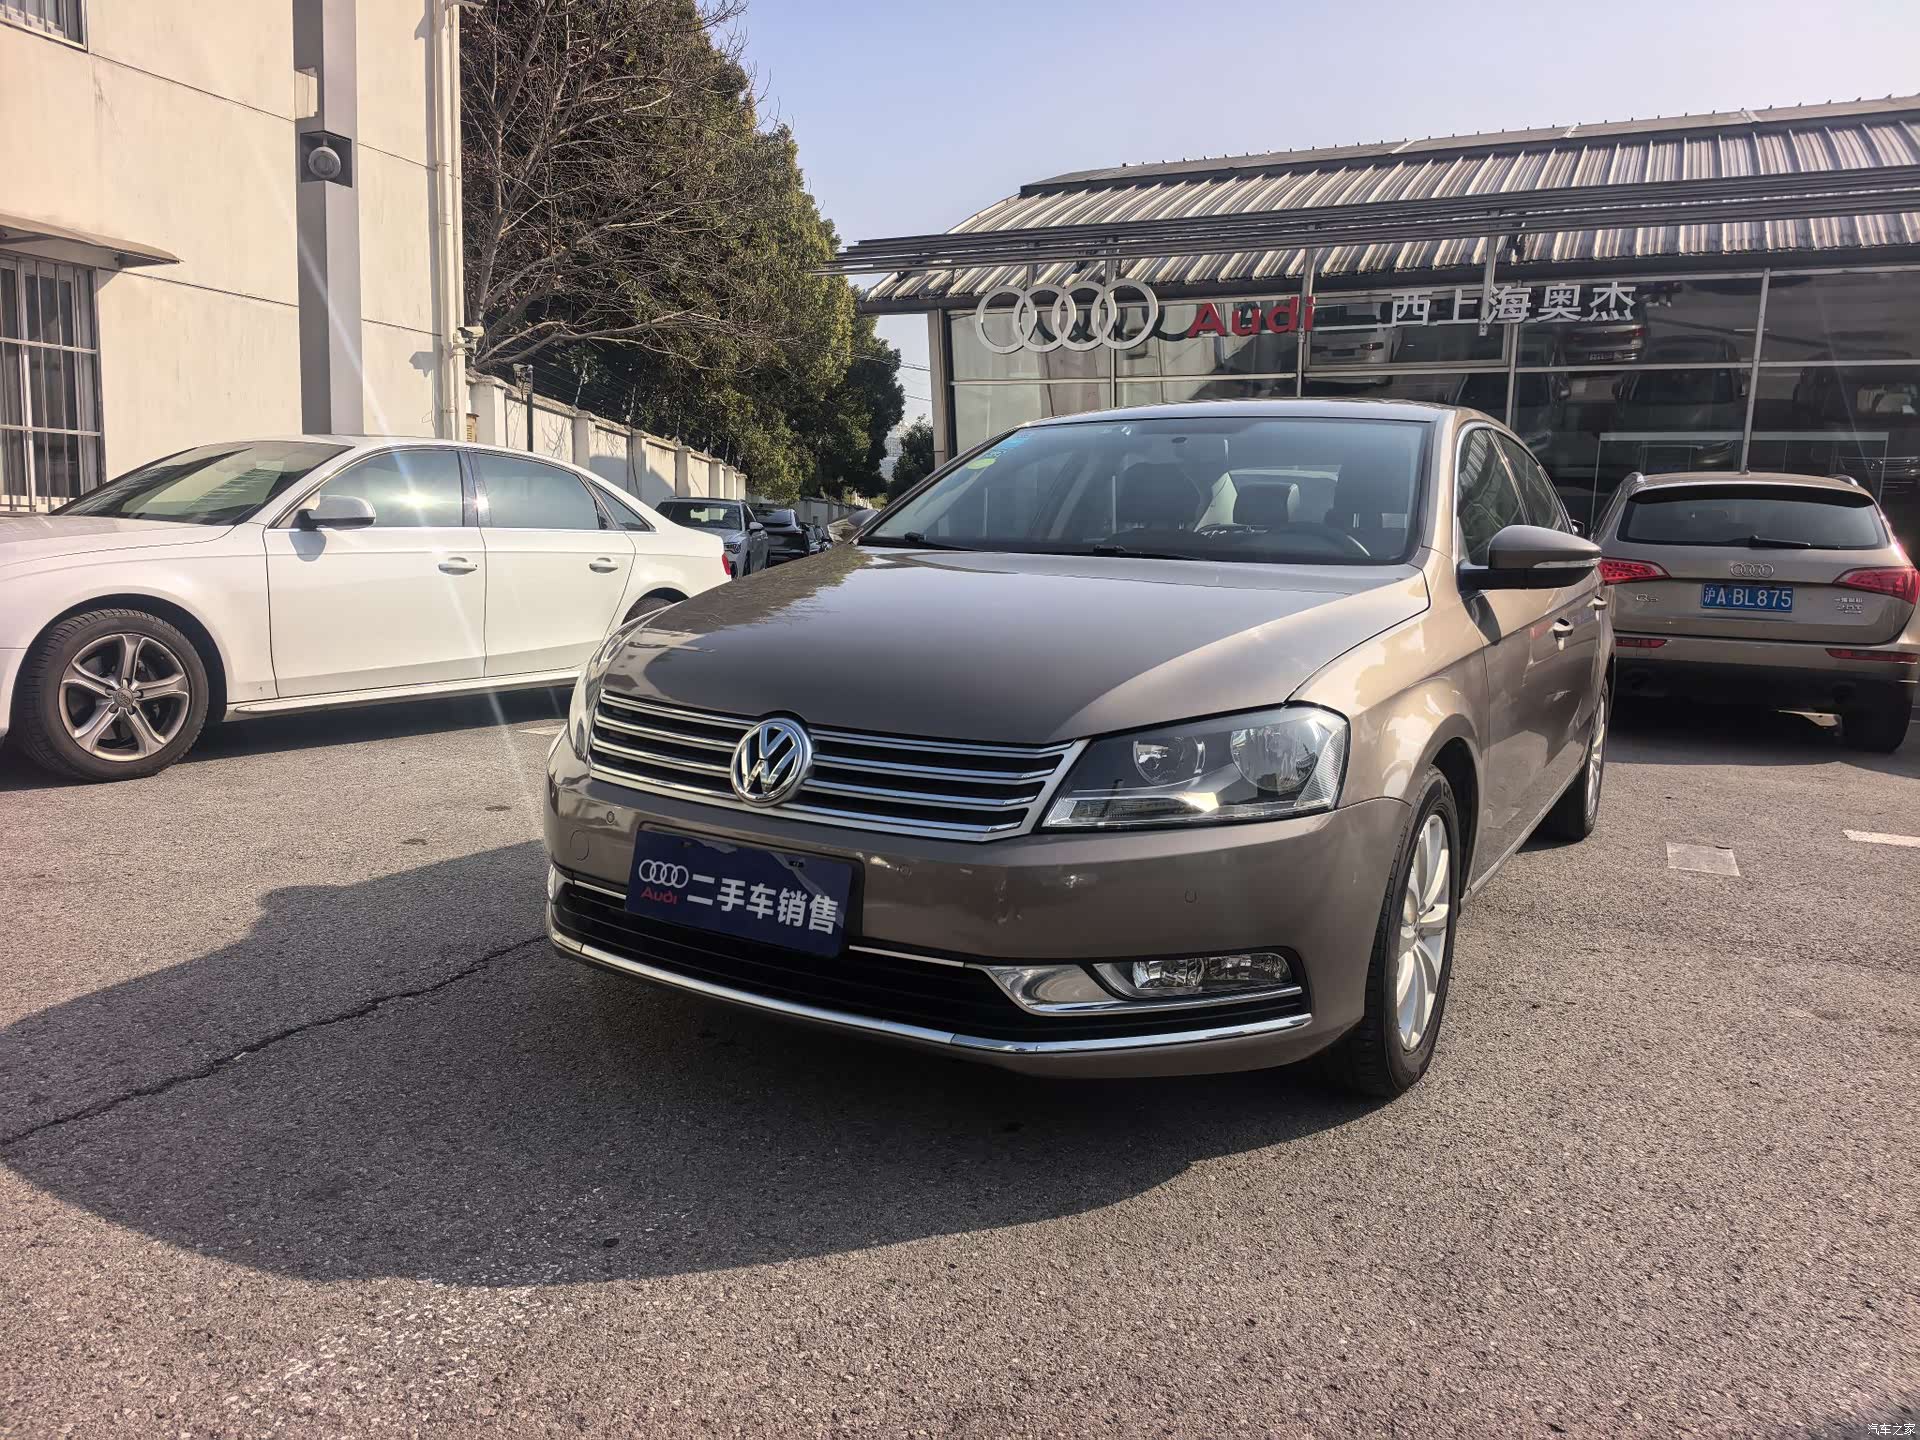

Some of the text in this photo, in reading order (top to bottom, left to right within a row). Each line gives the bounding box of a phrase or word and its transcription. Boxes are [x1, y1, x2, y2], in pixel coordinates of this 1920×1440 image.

[1186, 296, 1314, 338] Audi
[1391, 281, 1637, 327] 西上海奥杰
[640, 886, 678, 905] Audi
[687, 873, 839, 935] 二手车销售
